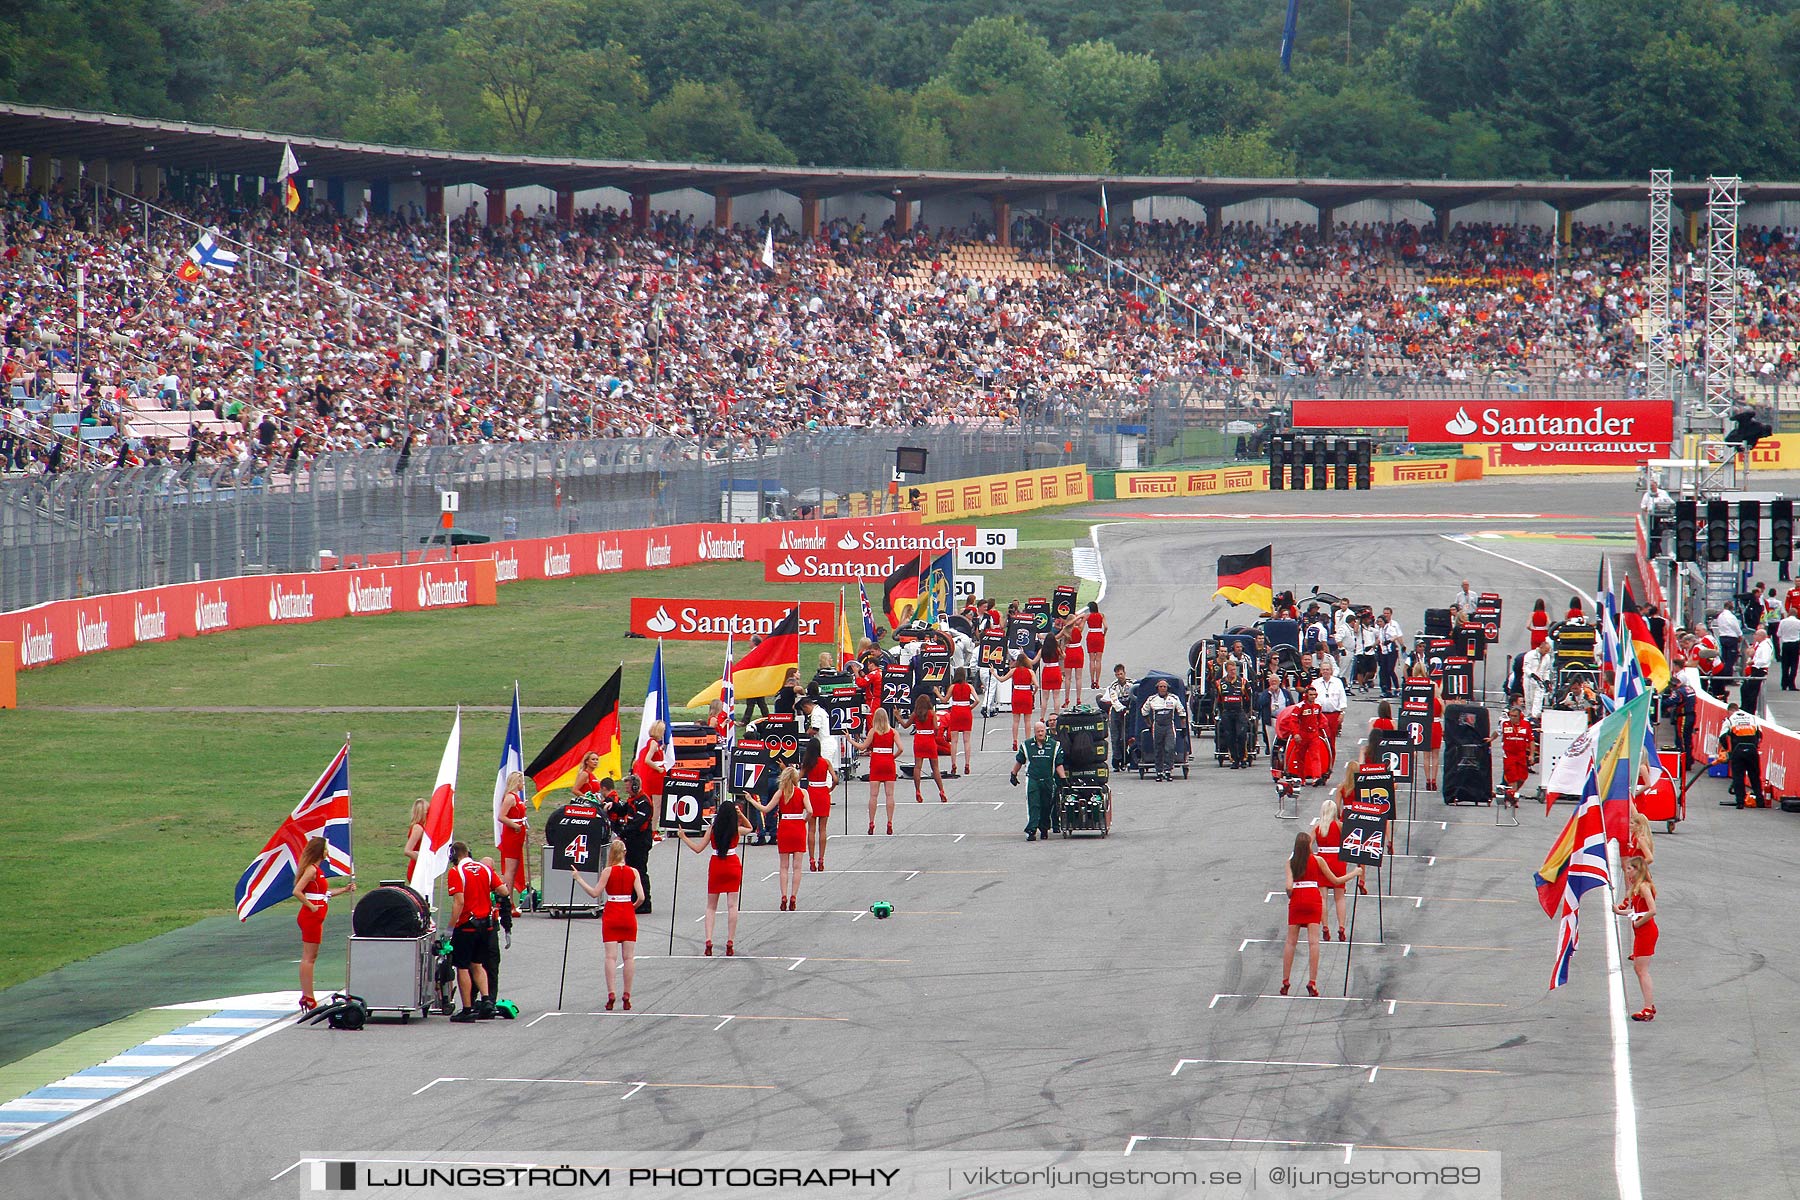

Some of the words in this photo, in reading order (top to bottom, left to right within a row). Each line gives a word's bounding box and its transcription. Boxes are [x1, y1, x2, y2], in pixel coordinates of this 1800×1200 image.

[1482, 407, 1634, 436] Santander
[1065, 471, 1083, 497] PIRELLI
[1188, 473, 1216, 491] PIRELLI
[1224, 470, 1252, 488] PIRELLI
[1393, 463, 1448, 481] PIRELLI
[990, 481, 1008, 506] PIRELLI
[1015, 478, 1034, 502] PIRELLI
[1040, 475, 1058, 500] PIRELLI
[1129, 476, 1177, 494] PIRELLI
[447, 494, 452, 509] 1
[936, 488, 955, 514] PIRELLI
[963, 485, 981, 511] PIRELLI
[706, 529, 745, 559] Santander
[788, 526, 827, 549] Santander
[862, 524, 966, 550] Santander
[986, 533, 1006, 545] 50
[549, 542, 571, 577] Santander
[602, 538, 623, 570] Santander
[650, 534, 671, 567] Santander
[965, 551, 996, 565] 100
[803, 556, 904, 577] Santand
[356, 572, 392, 612] Santander
[426, 567, 468, 606] Santander
[200, 586, 228, 630] Santander
[276, 579, 314, 620] Santander
[1057, 600, 1071, 616] 6
[82, 605, 108, 652] Santander
[138, 596, 165, 641] Santander
[26, 616, 54, 666] Santander
[1016, 628, 1030, 647] 3
[982, 645, 1004, 664] 14
[922, 661, 949, 681] 27
[883, 682, 911, 704] 22
[1448, 674, 1468, 694] 11
[831, 707, 860, 730] 25
[765, 734, 797, 758] 99
[734, 763, 766, 788] 17
[1382, 751, 1409, 777] 21
[666, 794, 699, 822] 10
[1360, 787, 1390, 815] 13
[565, 835, 588, 864] 4
[1342, 828, 1383, 859] 44
